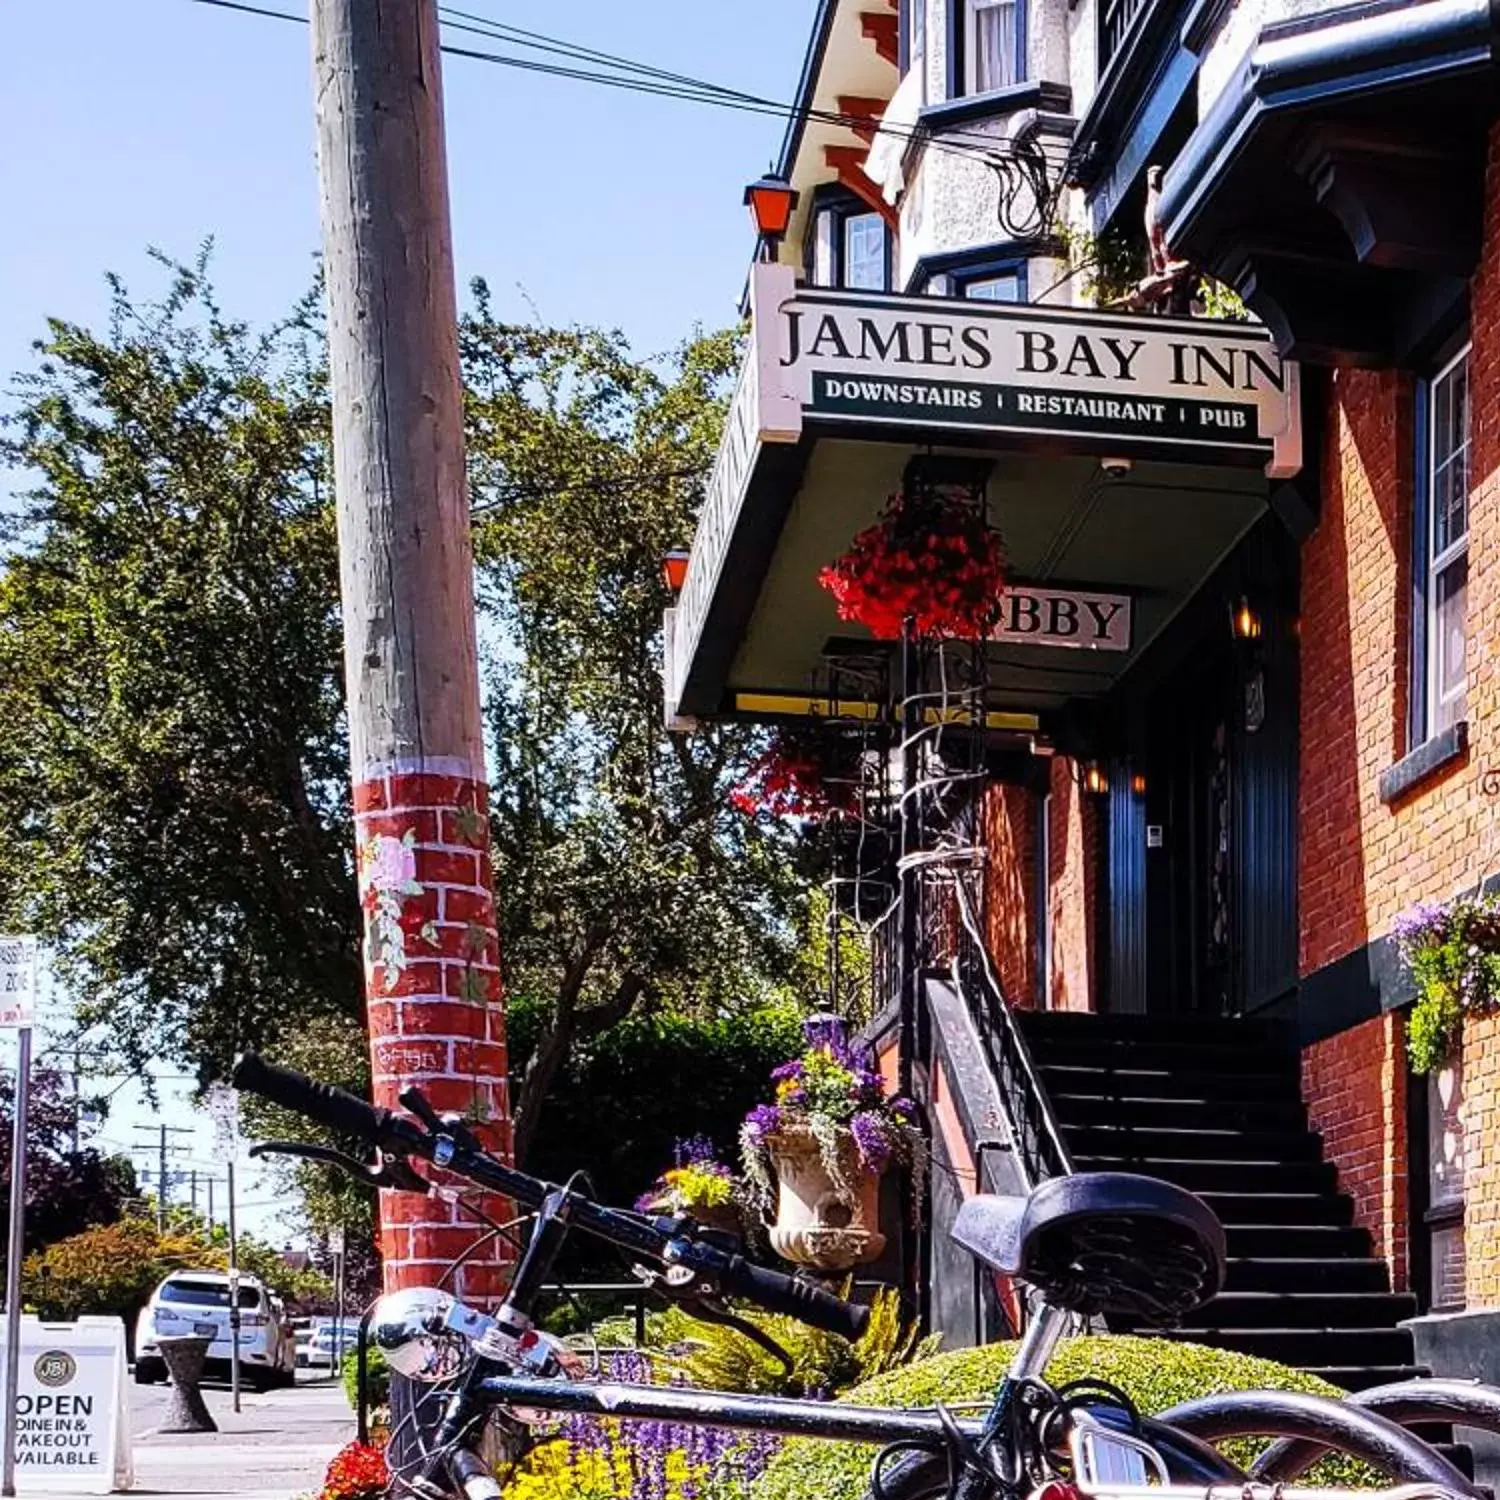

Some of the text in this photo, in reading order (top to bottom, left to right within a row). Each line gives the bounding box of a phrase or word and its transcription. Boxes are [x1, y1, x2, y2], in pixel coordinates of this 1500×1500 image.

[779, 310, 1286, 393] JAMES BAY INN
[825, 378, 1247, 429] DOWNSTAIRS RESTAURANT PUB
[988, 594, 1124, 640] BBY
[15, 1395, 93, 1416] OPEN
[15, 1418, 87, 1432] DINE IN &
[15, 1433, 93, 1447] AKEOUT
[14, 1451, 100, 1466] VAILABLE
